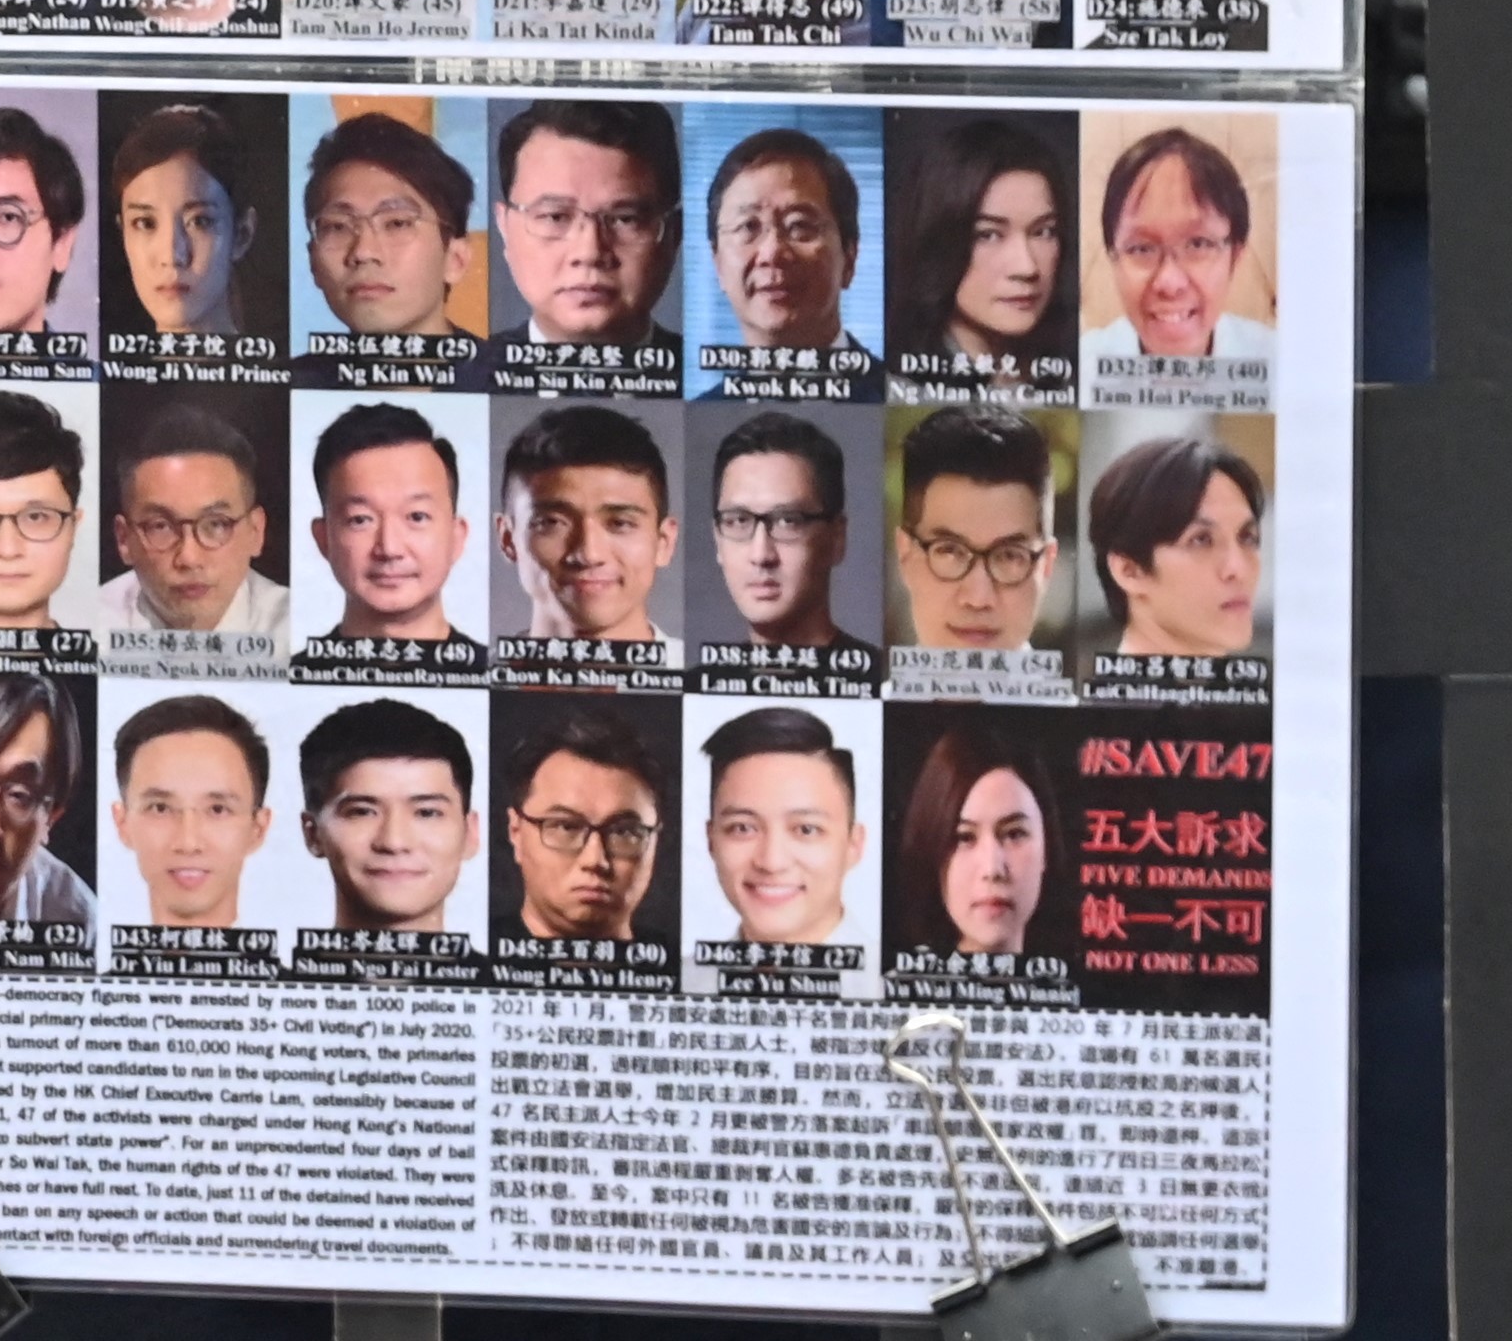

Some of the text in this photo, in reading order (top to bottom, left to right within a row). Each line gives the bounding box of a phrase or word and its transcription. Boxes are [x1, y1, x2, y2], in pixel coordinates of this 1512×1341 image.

[290, 19, 470, 41] Tam Man Ho Jeremy
[493, 20, 656, 41] Li Ka Tat Kinda
[709, 23, 842, 45] Tam Tak Chi
[46, 335, 88, 359] (27)
[234, 337, 276, 361] (23)
[436, 337, 477, 362] (25)
[10, 361, 49, 379] Sum
[54, 361, 93, 380] Sam
[103, 360, 293, 384] Wong Ji Yuet Prince
[337, 363, 456, 388] Ng Kin Wai
[828, 649, 872, 673] (43)
[700, 672, 873, 700] Lam Cheuk Ting
[1079, 736, 1273, 782] #SAVE47
[1080, 808, 1268, 858] 五大訴求
[1079, 863, 1272, 891] FIVE DEMANDS
[1080, 892, 1266, 945] 缺一不可
[44, 924, 86, 947] (32)
[3, 949, 45, 968] Nam
[49, 950, 95, 969] Mike
[625, 942, 668, 967] (30)
[1084, 948, 1260, 976] NOT ONE LESS
[492, 963, 675, 992] Wong Pak Yu Henry
[91, 988, 142, 1006] figures
[148, 992, 182, 1004] were
[190, 992, 250, 1007] arrested
[257, 993, 273, 1011] by
[280, 996, 317, 1009] more
[324, 996, 357, 1010] than
[366, 997, 405, 1012] 1000
[411, 998, 456, 1016] police
[463, 1000, 476, 1014] in
[29, 1012, 85, 1029] primary
[90, 1014, 147, 1028] election
[248, 1017, 278, 1032] 35+
[283, 1018, 314, 1033] Civil
[381, 1021, 395, 1035] in
[399, 1022, 426, 1040] July
[431, 1023, 476, 1039] 2020.
[181, 1135, 476, 1161] For an unprecedented four days of bail
[132, 1231, 455, 1256] officials and surrendering travel documents.
